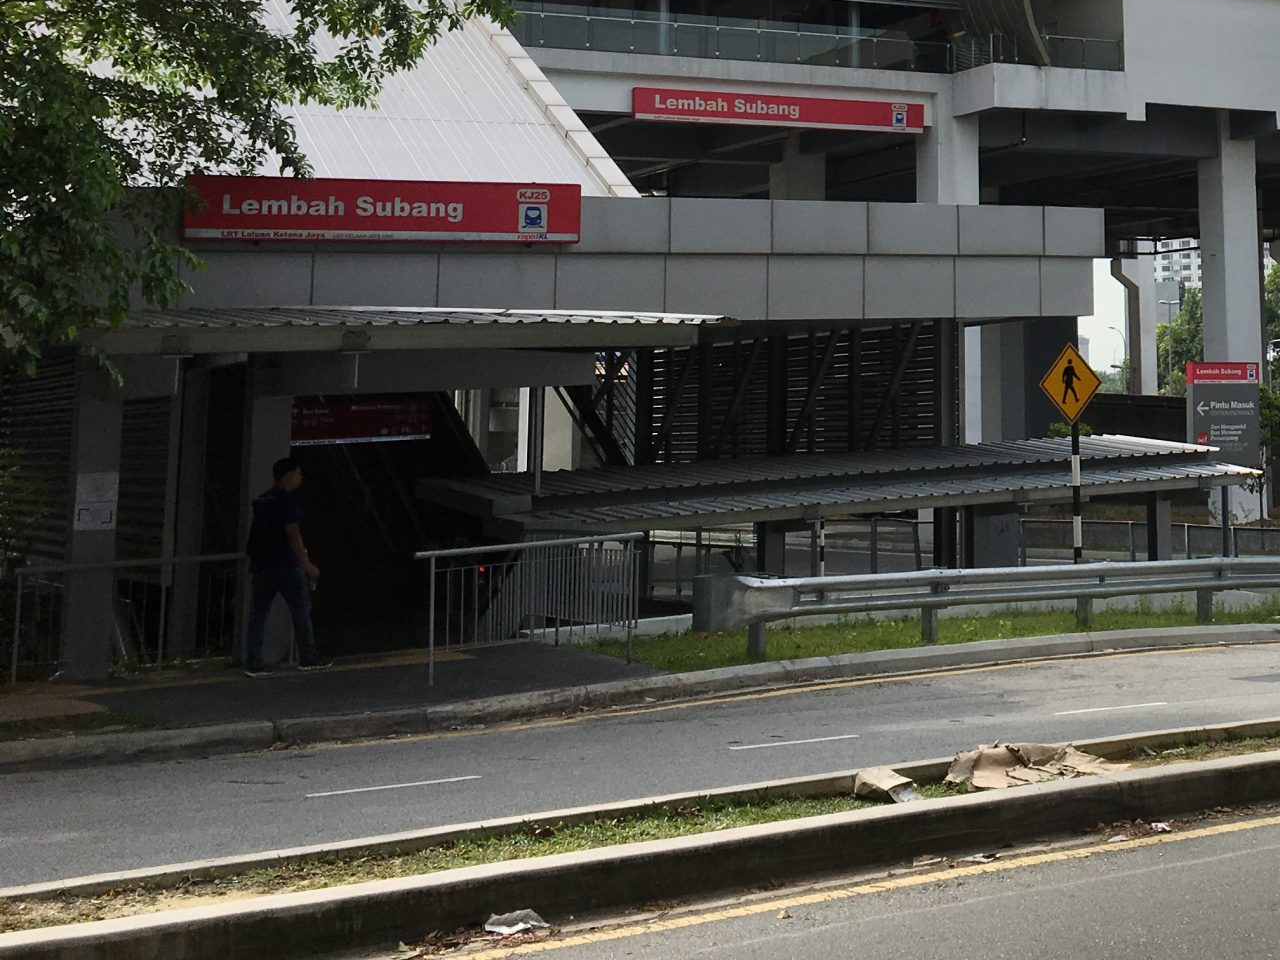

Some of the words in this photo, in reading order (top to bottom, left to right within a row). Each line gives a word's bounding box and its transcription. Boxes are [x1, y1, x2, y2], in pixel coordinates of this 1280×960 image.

[655, 94, 728, 113] Lembah
[734, 99, 800, 119] Subang
[519, 191, 548, 200] KJ25
[222, 194, 345, 216] Lembah
[355, 196, 464, 223] Subang
[241, 230, 271, 238] Laluan
[305, 231, 326, 239] Jaya
[1220, 368, 1242, 376] Subang
[1210, 401, 1230, 409] Pintu
[1231, 401, 1255, 409] Masuk
